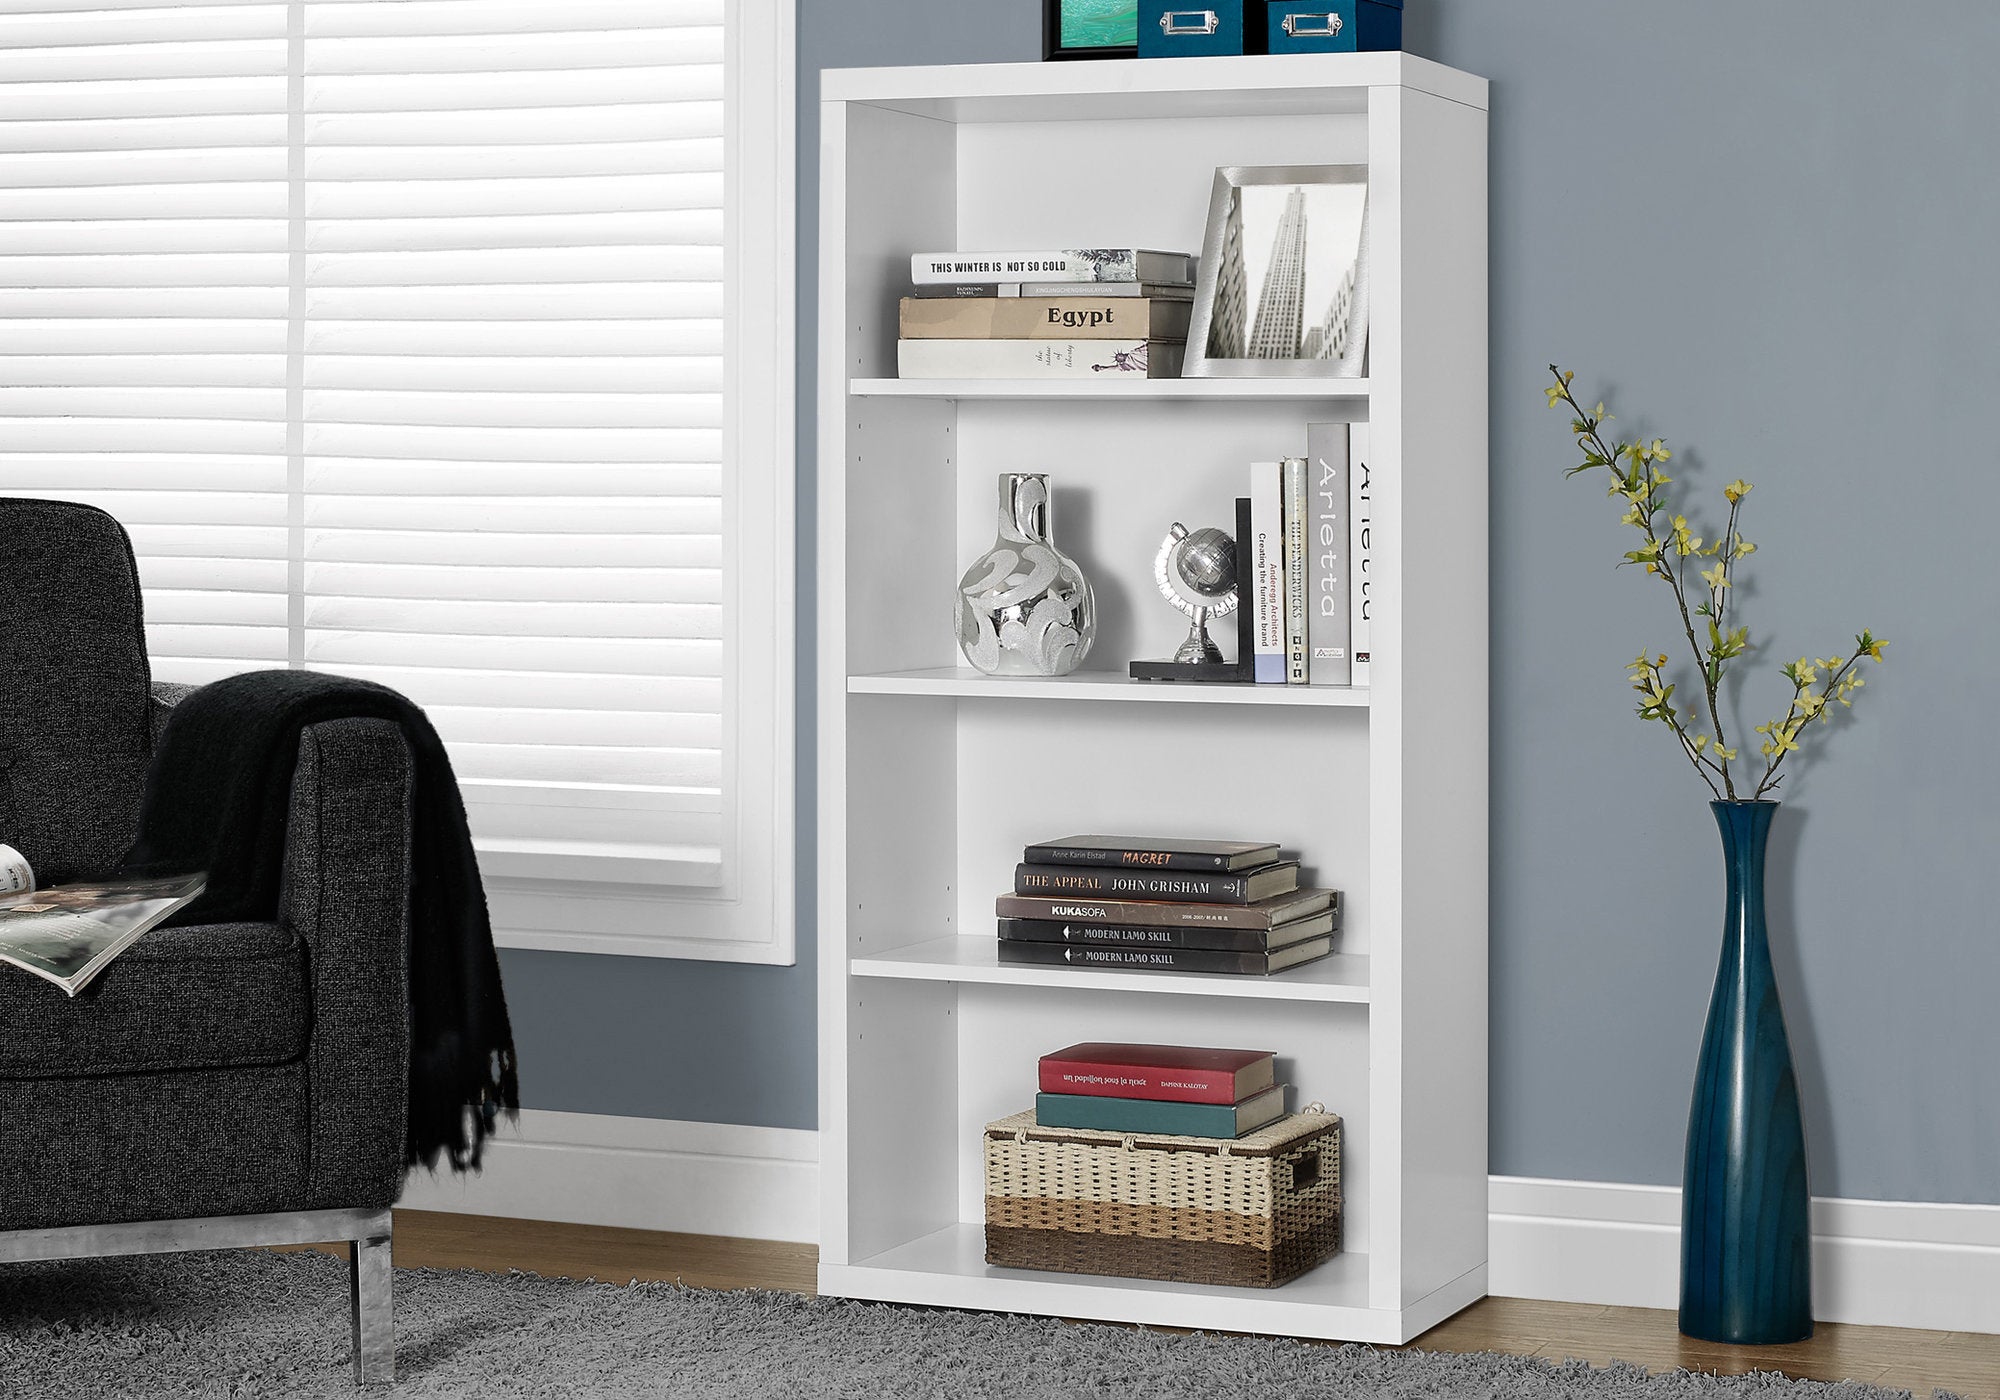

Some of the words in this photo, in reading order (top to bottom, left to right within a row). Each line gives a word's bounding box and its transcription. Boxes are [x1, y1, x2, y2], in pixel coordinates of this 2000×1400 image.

[931, 263, 952, 273] THIS
[955, 262, 989, 273] WINTER
[993, 262, 1001, 272] IS
[1007, 262, 1025, 272] NOT
[1028, 261, 1039, 271] SO
[1042, 261, 1066, 271] COLD
[1048, 308, 1114, 327] Egypt
[1291, 520, 1301, 541] THE
[1319, 458, 1337, 617] Arletta
[1258, 533, 1266, 568] Creating
[1269, 563, 1277, 603] Anderegg
[1291, 543, 1302, 618] PENDERWICKS
[1260, 586, 1268, 620] furniture
[1261, 623, 1269, 646] brand
[1271, 604, 1279, 646] Architects
[1052, 850, 1068, 859] Anne
[1069, 851, 1086, 859] Karin
[1087, 851, 1106, 860] Elstad
[1122, 852, 1172, 865] MAGRET
[1024, 875, 1049, 887] THE
[1053, 877, 1102, 889] APPEAL
[1111, 879, 1146, 891] JOHN
[1150, 880, 1210, 894] GRISHAM
[1084, 929, 1120, 939] MODERN
[1122, 930, 1146, 941] LAMO
[1148, 932, 1172, 942] SKILL
[1086, 951, 1122, 961] MODERN
[1124, 953, 1148, 963] LAMO
[1150, 954, 1174, 964] SKILL
[1063, 1074, 1073, 1082] un
[1074, 1075, 1103, 1084] papillon
[1120, 1077, 1127, 1086] la
